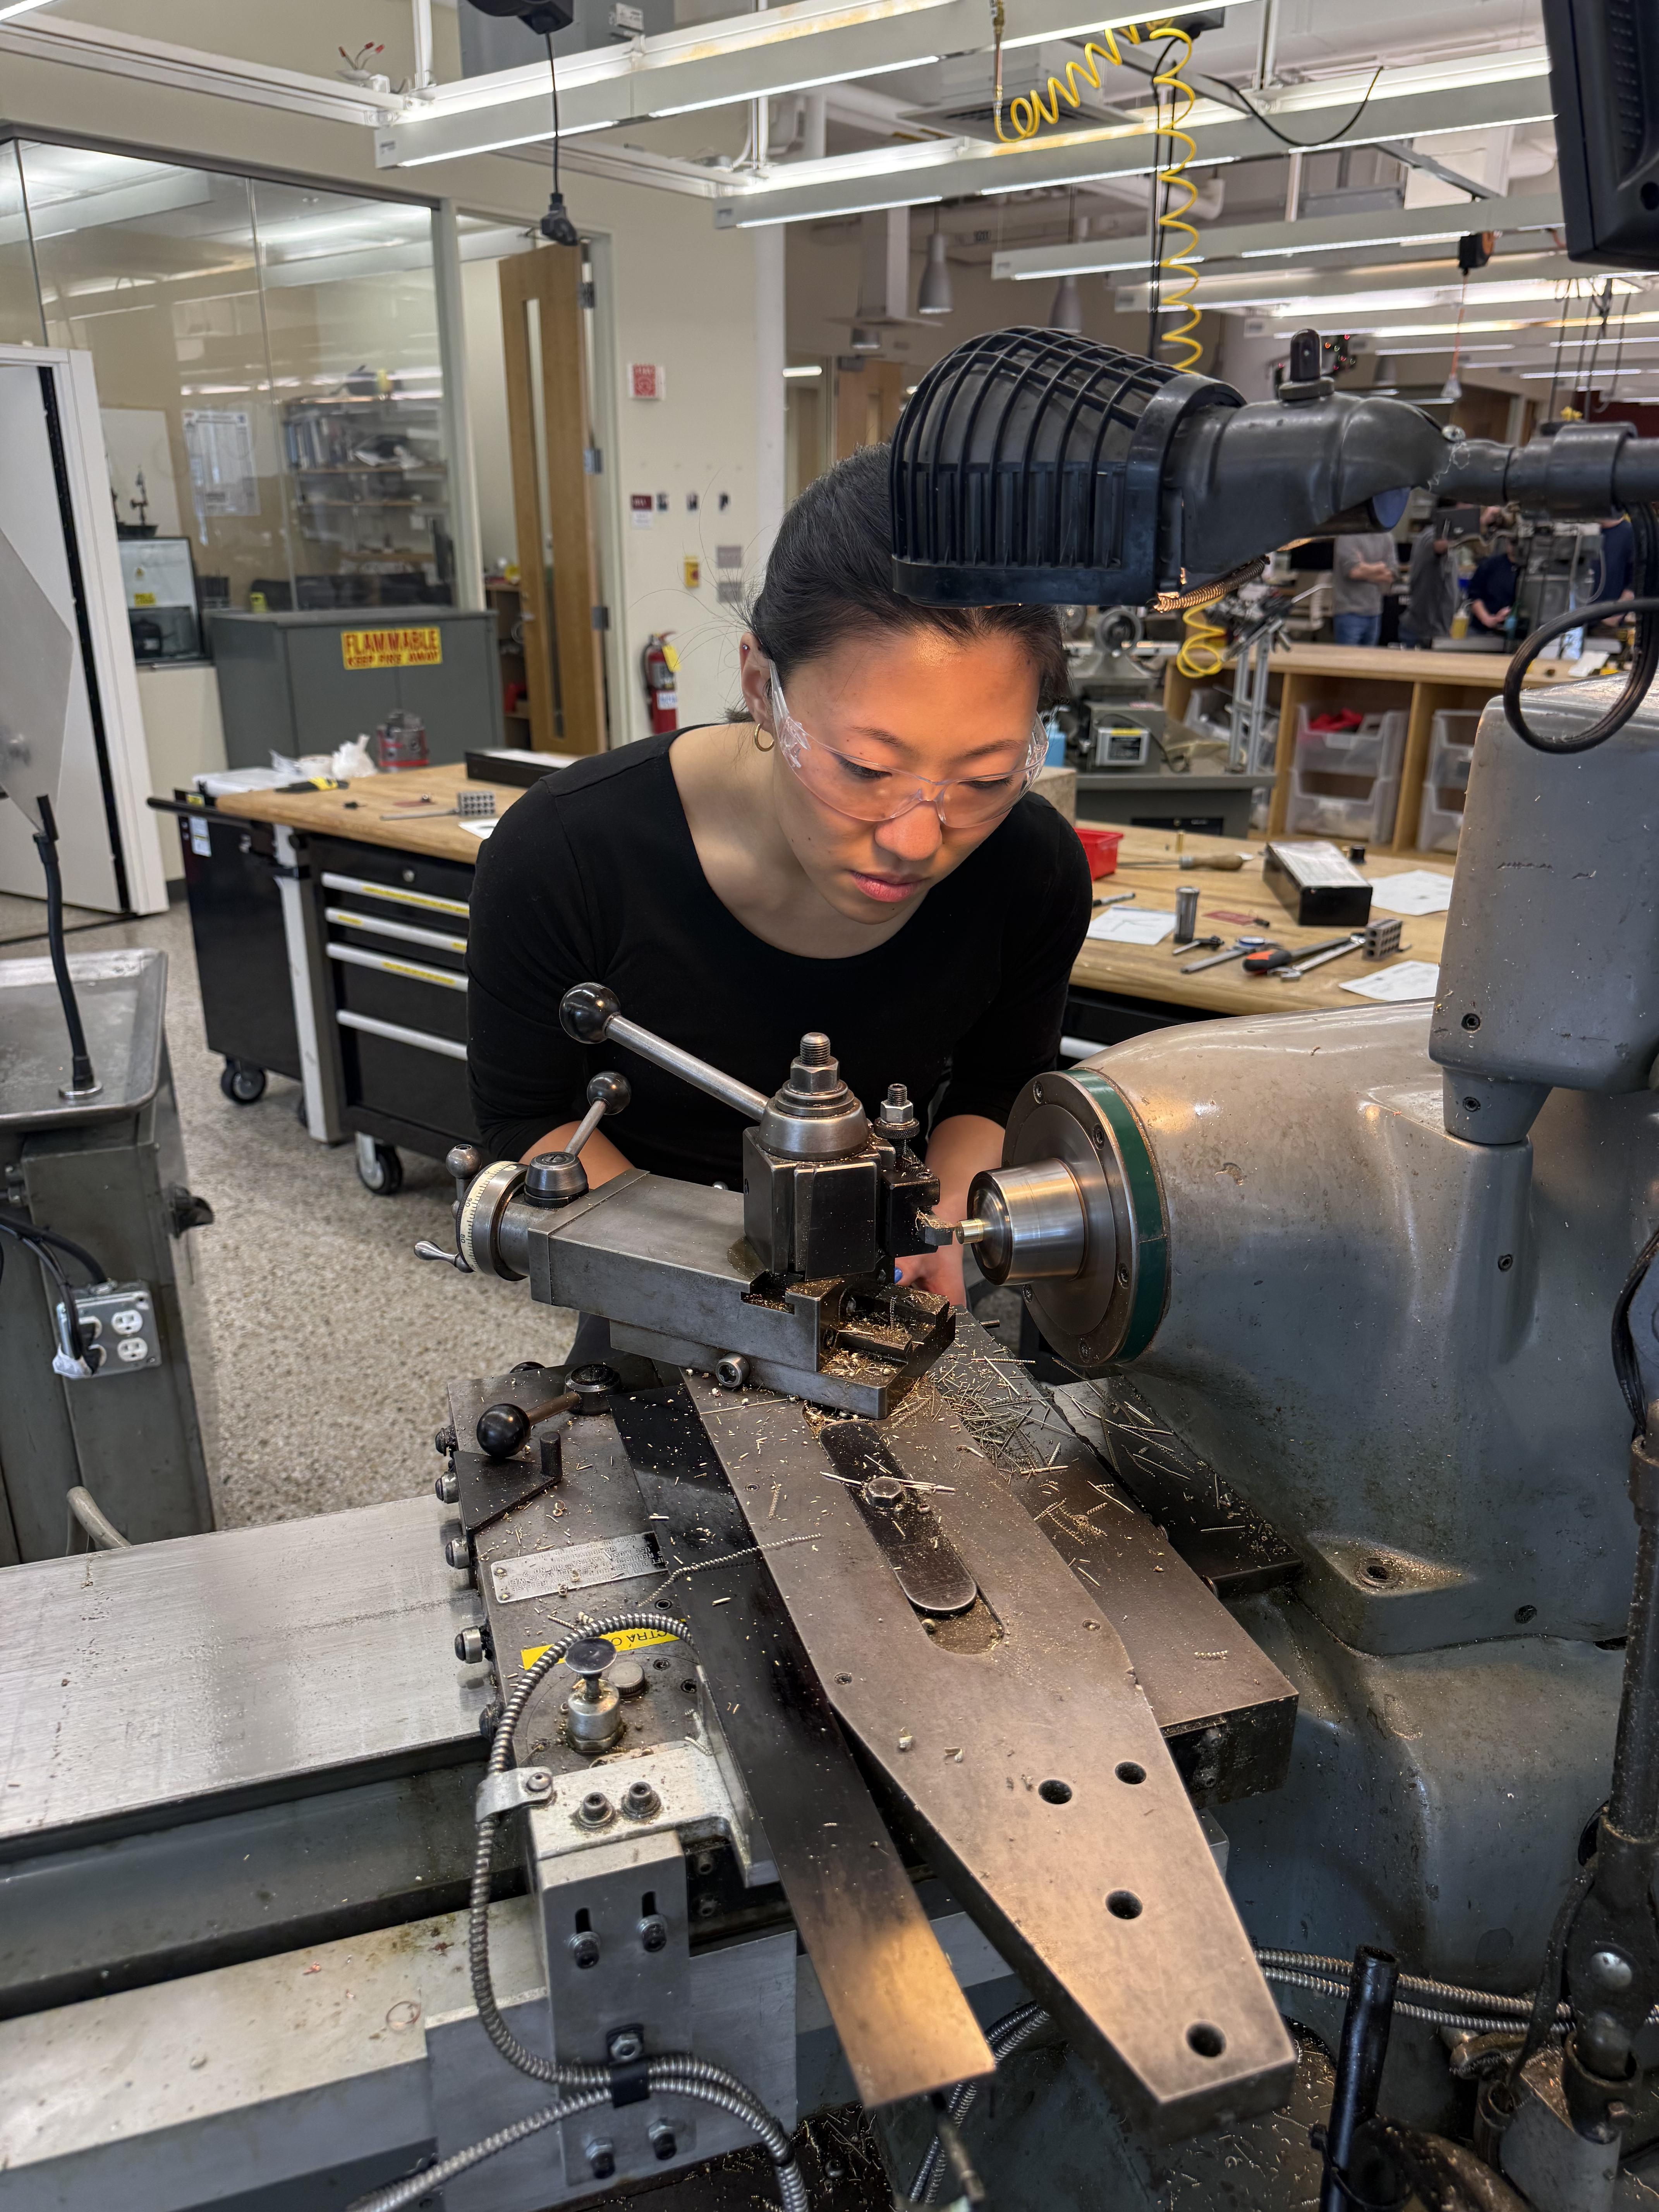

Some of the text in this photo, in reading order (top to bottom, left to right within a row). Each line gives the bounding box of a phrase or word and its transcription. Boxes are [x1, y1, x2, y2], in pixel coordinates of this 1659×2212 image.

[460, 1234, 465, 1243] 80
[608, 1550, 631, 1559] MOBI
[529, 1572, 554, 1582] WAYS
[508, 1578, 526, 1586] WET
